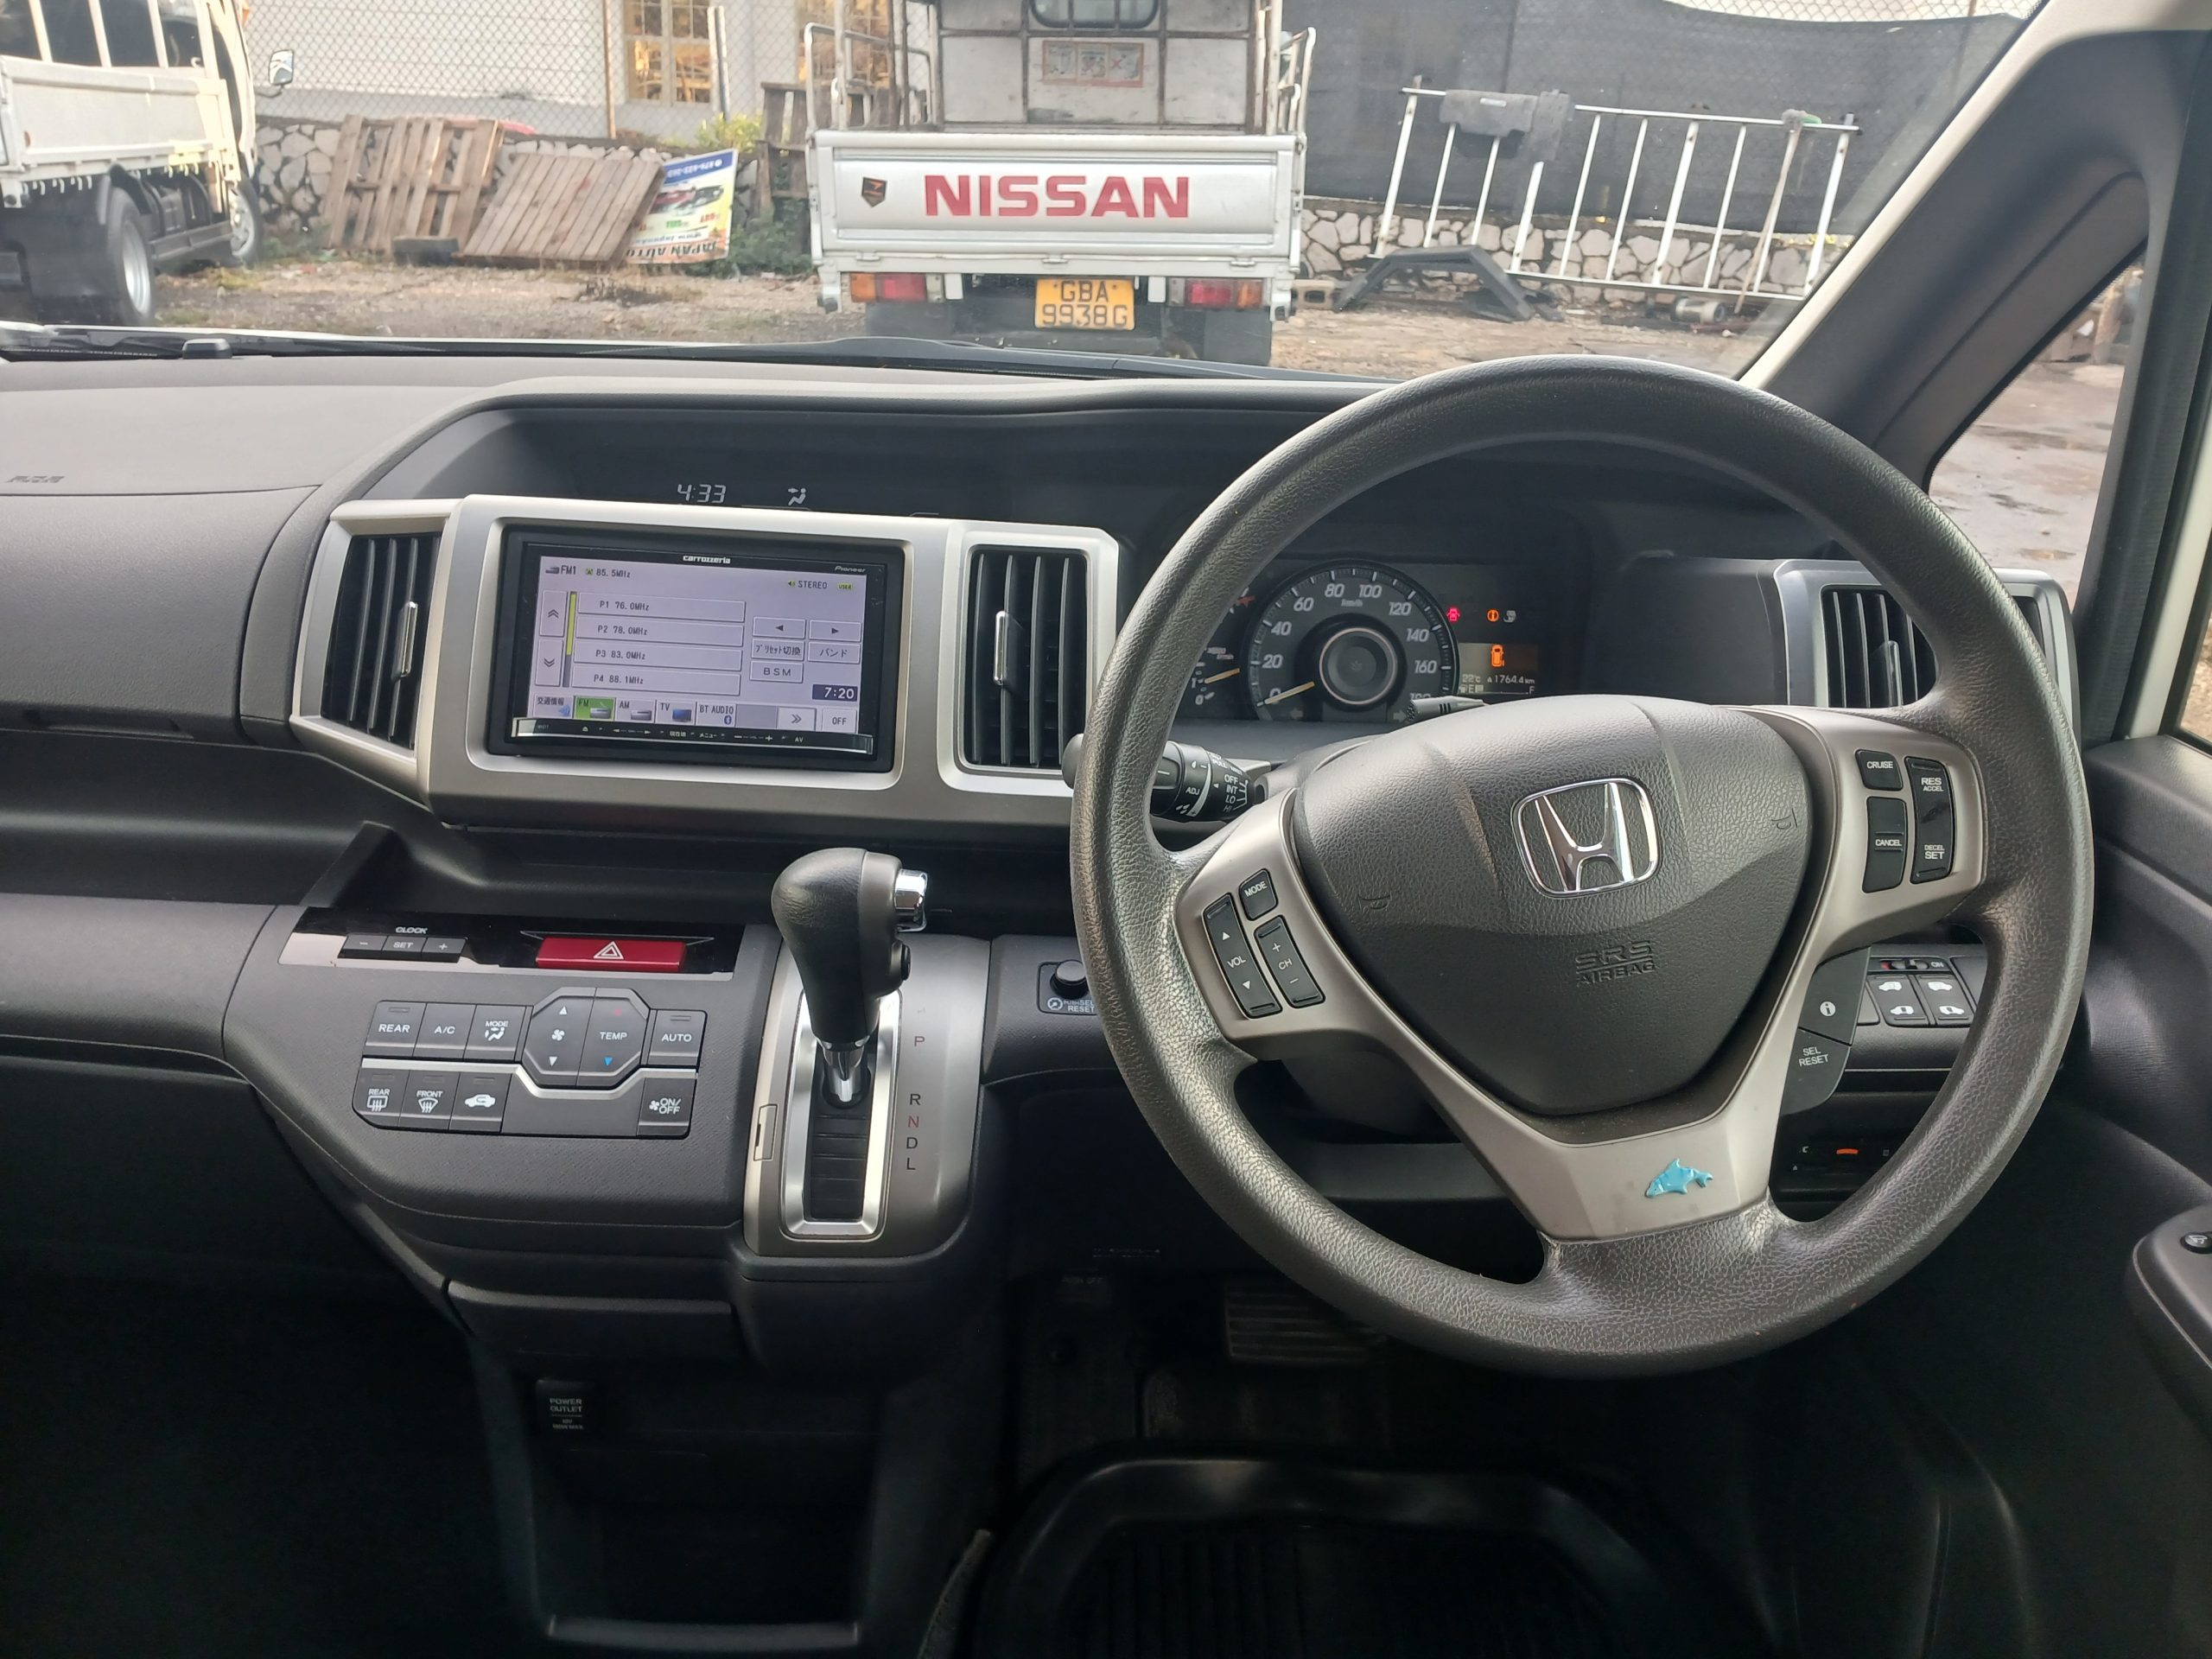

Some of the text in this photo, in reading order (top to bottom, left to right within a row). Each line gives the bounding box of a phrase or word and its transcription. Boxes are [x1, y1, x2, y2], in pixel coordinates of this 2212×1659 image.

[924, 175, 1189, 219] NISSAN
[671, 241, 717, 257] JAPAN
[1058, 279, 1110, 303] GBA
[1042, 303, 1129, 327] 9938G
[677, 484, 726, 503] 4:33
[683, 555, 731, 564] carrozzeria
[561, 565, 576, 575] FM1
[798, 580, 828, 589] STEREO
[1324, 583, 1344, 598] 80
[1358, 584, 1382, 599] 100
[1293, 597, 1314, 612] 60
[1389, 601, 1412, 616] 120
[597, 625, 607, 633] P2
[1270, 621, 1292, 636] 40
[1406, 628, 1429, 642] 140
[820, 648, 848, 658] バンド
[1262, 654, 1283, 669] 20
[1414, 659, 1437, 674] 160
[594, 674, 604, 683] P4
[1495, 675, 1524, 683] 1764.4
[824, 687, 855, 699] 7:20
[660, 702, 670, 711] TV
[699, 704, 734, 715] BT AUDIO
[831, 716, 847, 726] OFF
[1224, 773, 1238, 785] OFF
[1921, 777, 1942, 785] RES
[1185, 786, 1200, 796] ADJ
[1226, 785, 1238, 794] INT
[1225, 795, 1236, 804] LO
[1924, 851, 1945, 860] SET
[1244, 881, 1268, 898] MODE
[1575, 939, 1652, 969] SRS
[1227, 956, 1247, 969] VOL
[1278, 958, 1293, 970] CH
[1576, 961, 1656, 988] AIRBAG
[378, 1023, 410, 1033] REAR
[434, 1026, 455, 1034] A/C
[600, 1032, 628, 1040] TEMP
[661, 1033, 692, 1042] AUTO
[914, 1035, 925, 1047] P
[1802, 1046, 1821, 1057] SEL
[1798, 1054, 1829, 1067] RESET
[659, 1097, 682, 1106] ON/
[909, 1093, 921, 1106] R
[658, 1106, 681, 1115] OFF
[907, 1116, 919, 1128] N
[906, 1136, 918, 1149] D
[906, 1157, 916, 1171] L
